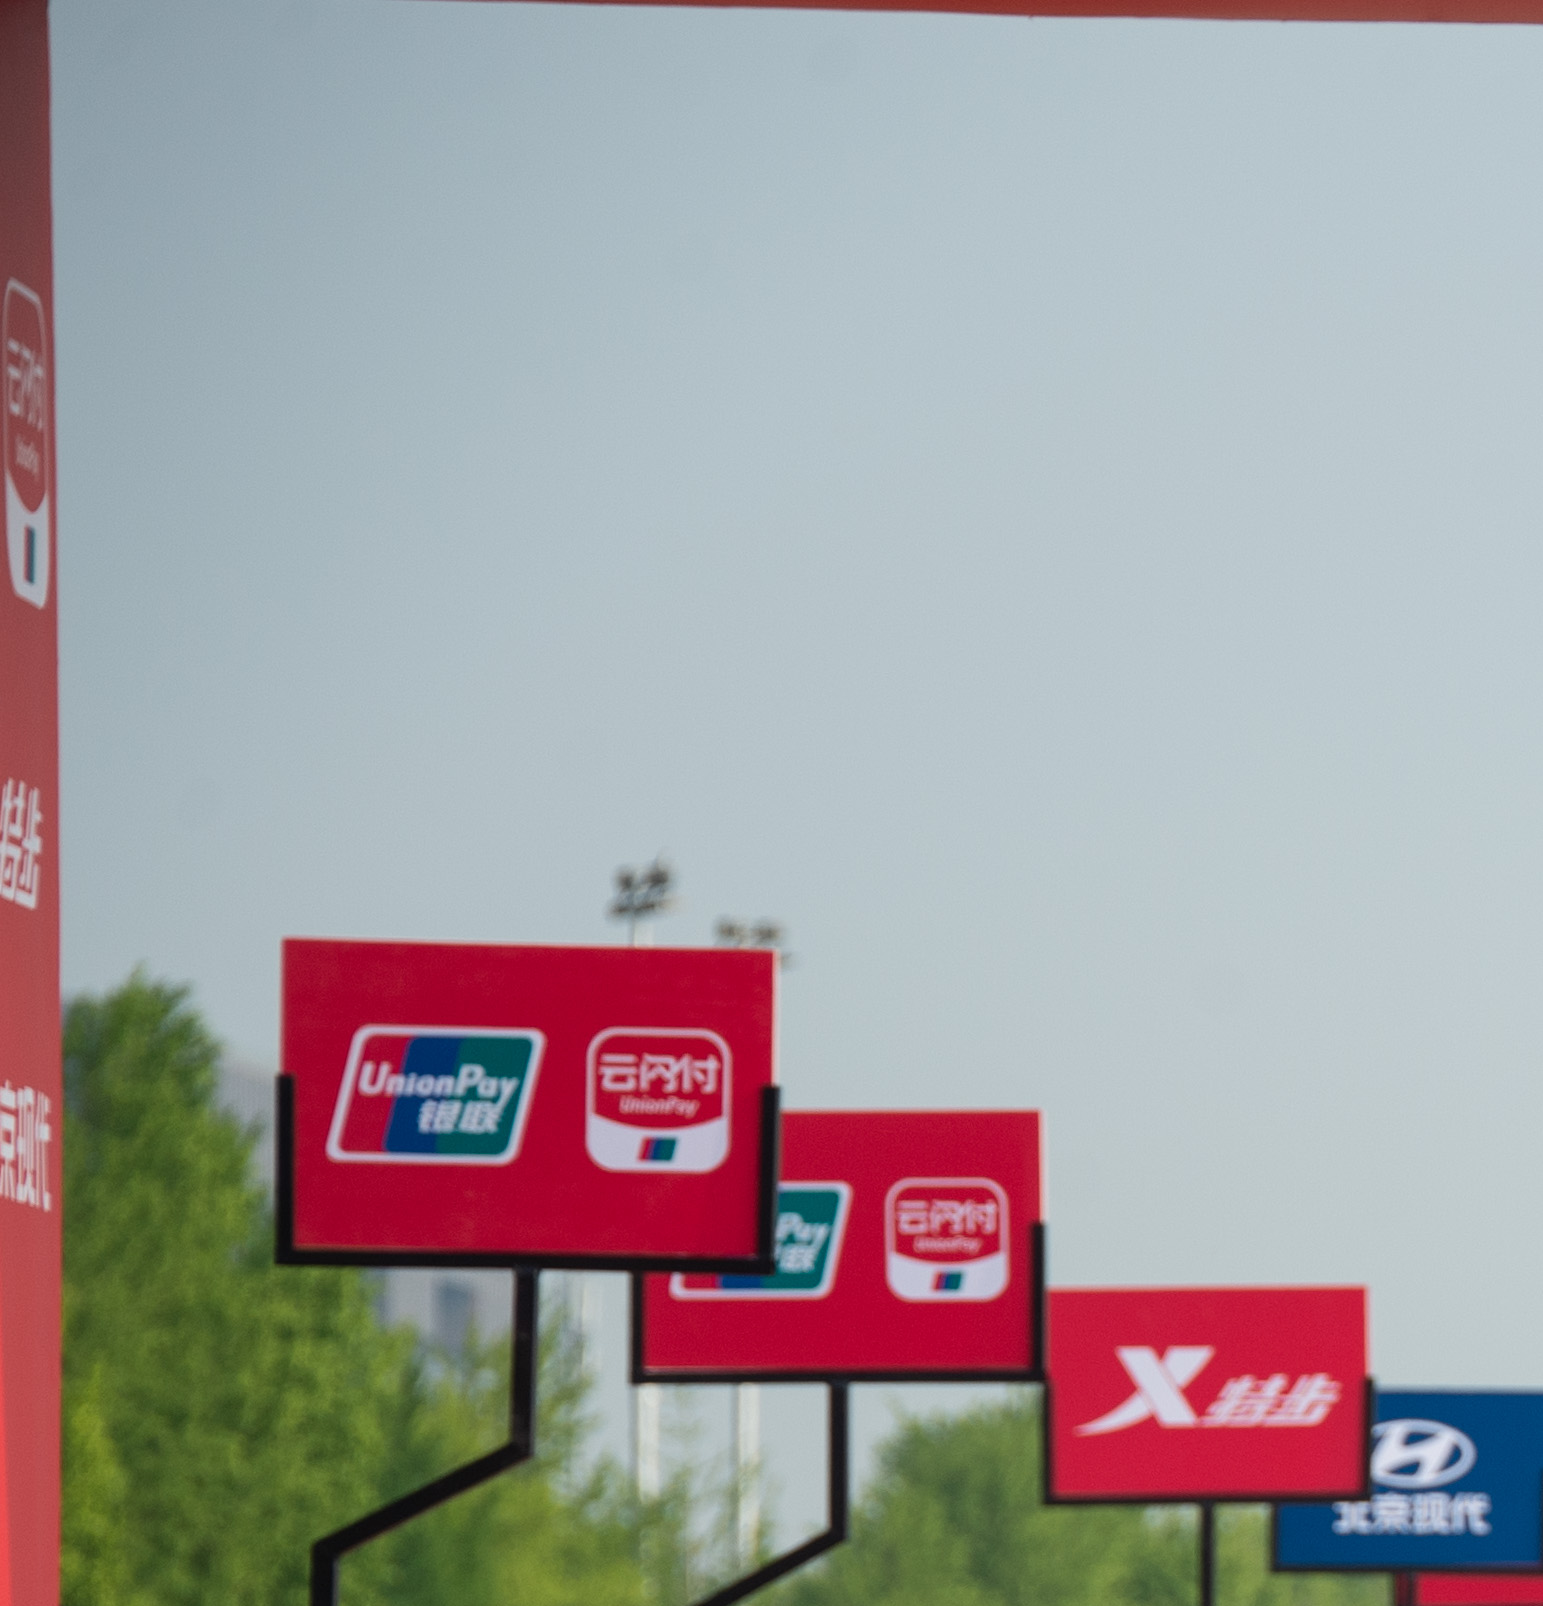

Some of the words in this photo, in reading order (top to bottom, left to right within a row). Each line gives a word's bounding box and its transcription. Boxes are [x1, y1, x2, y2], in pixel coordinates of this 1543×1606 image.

[357, 1060, 520, 1108] UnionPay
[599, 1052, 722, 1095] 云闪付
[417, 1099, 501, 1134] 银联
[895, 1200, 998, 1236] 云闪付
[1196, 1372, 1343, 1428] 特步
[1332, 1491, 1493, 1536] 北京现代
